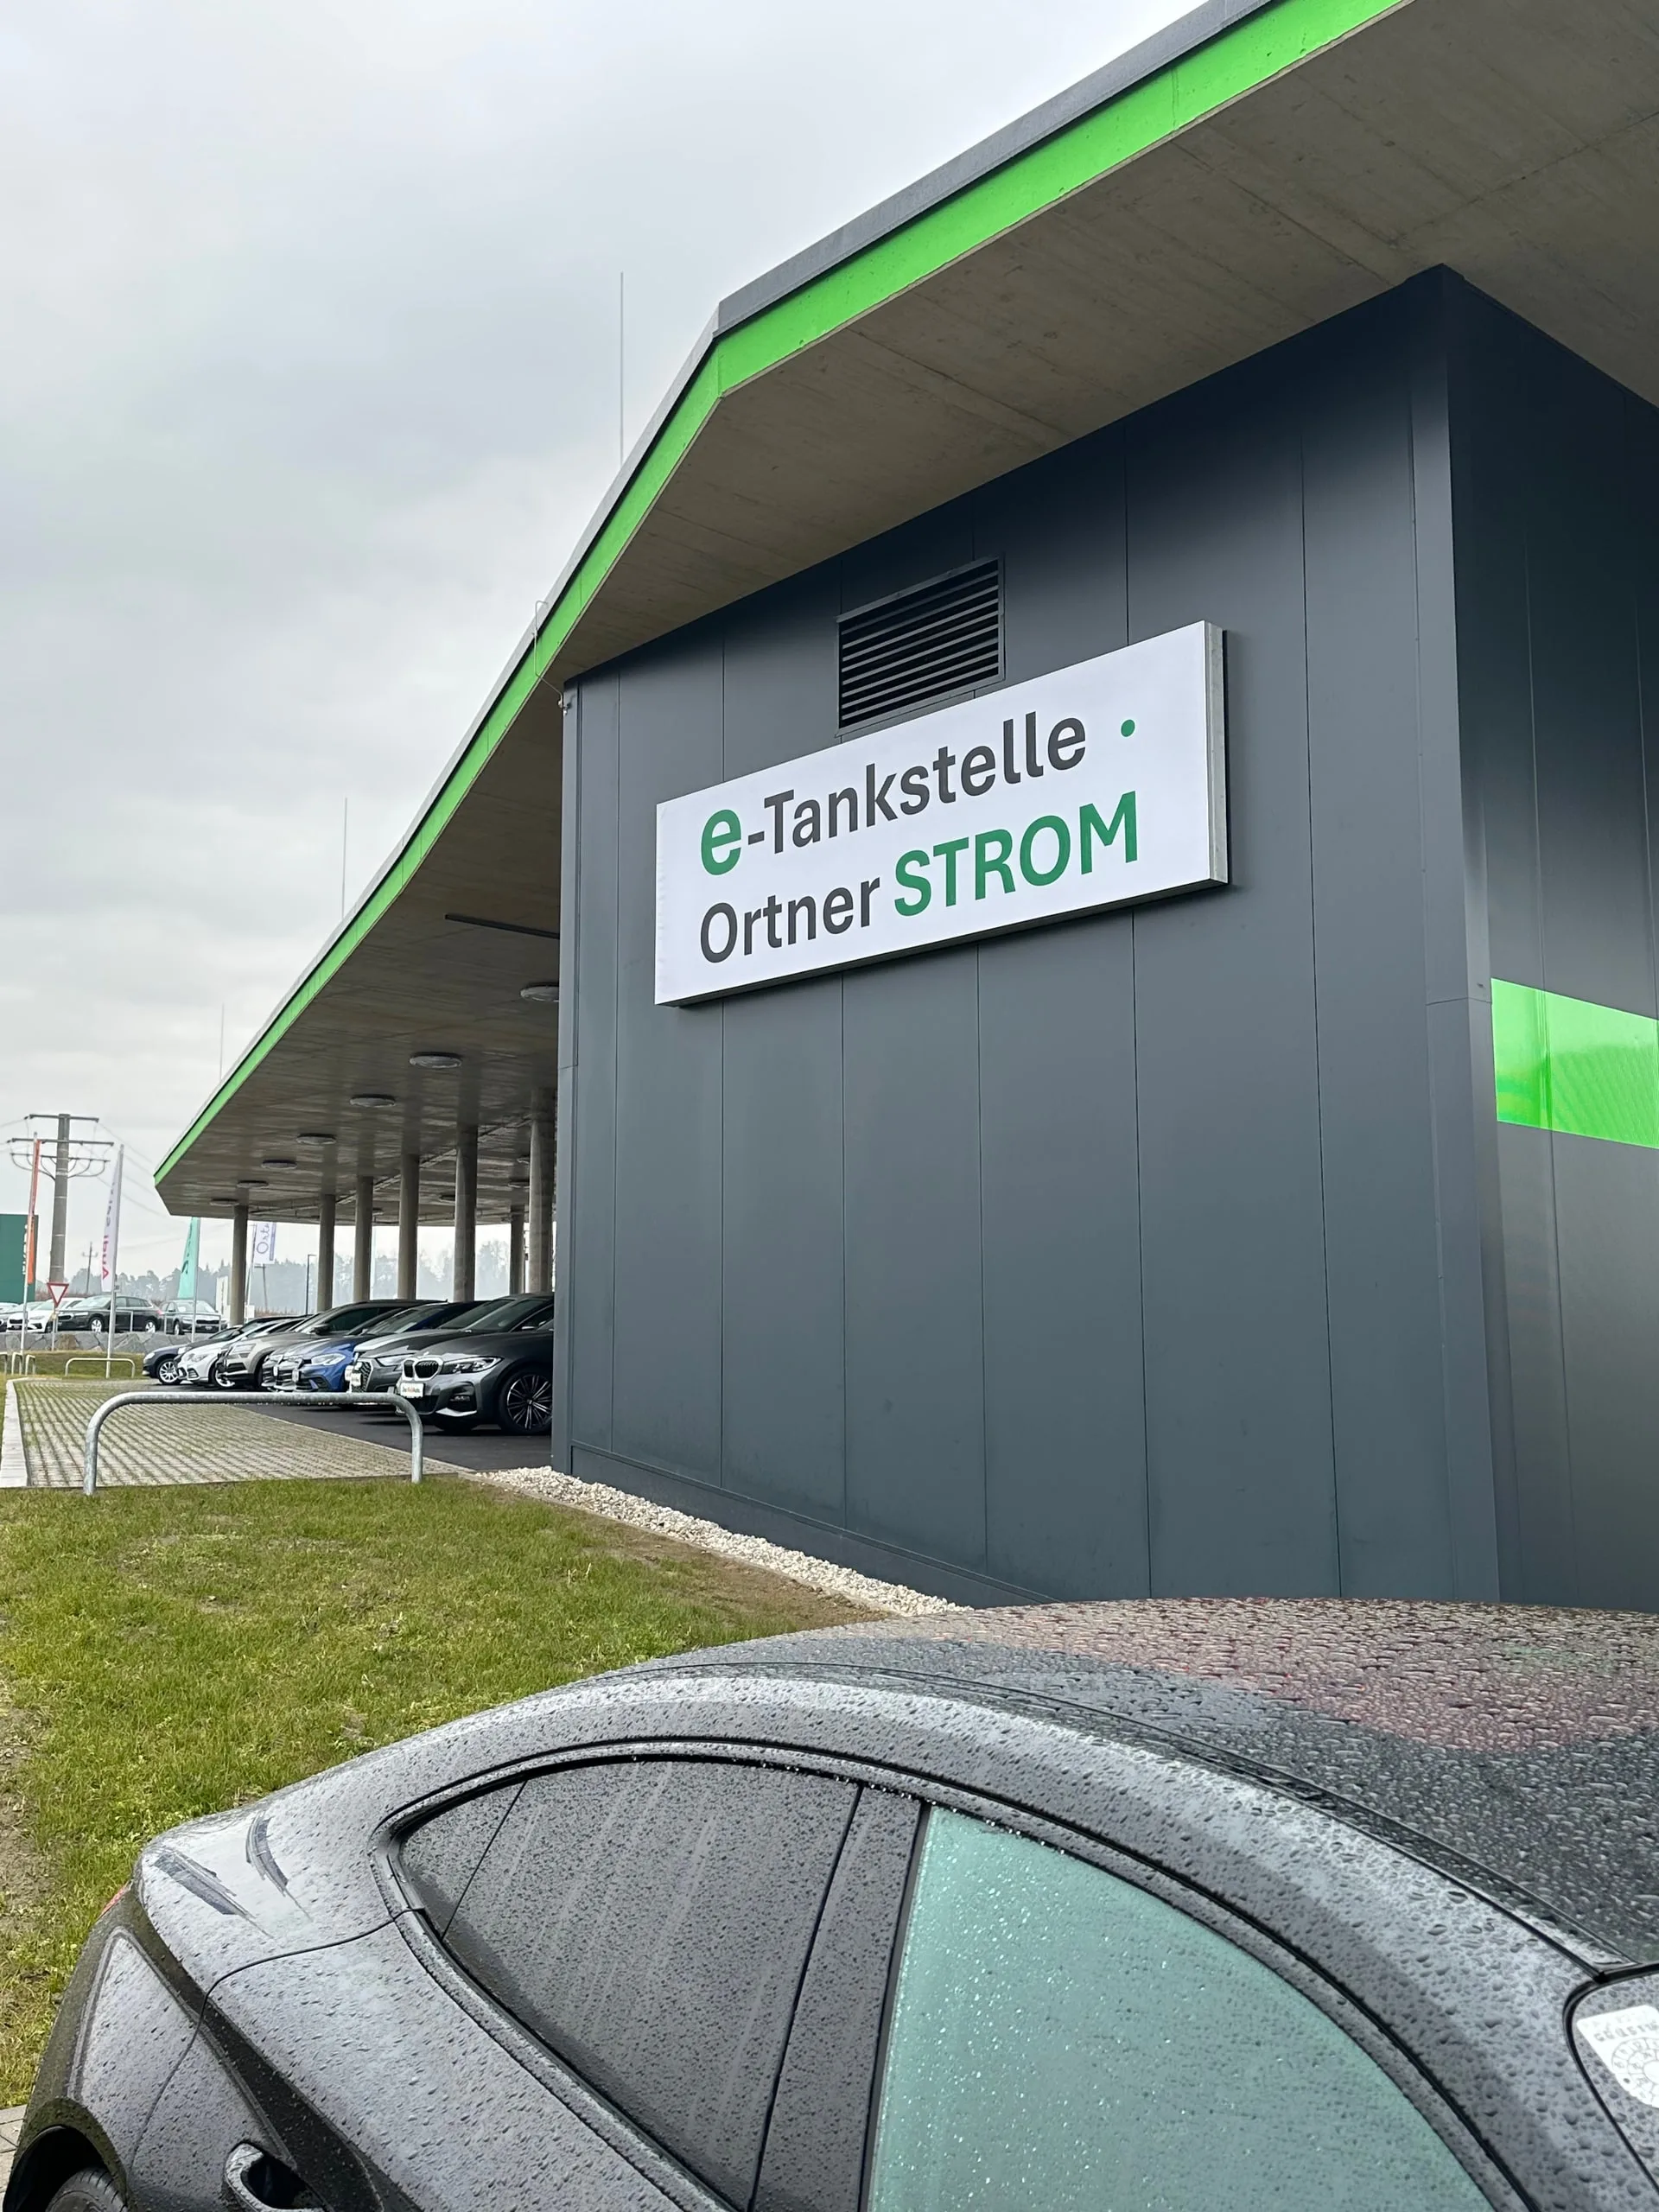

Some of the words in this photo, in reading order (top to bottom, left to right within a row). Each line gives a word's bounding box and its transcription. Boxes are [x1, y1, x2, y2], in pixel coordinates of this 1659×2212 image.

[700, 711, 1086, 875] e-Tankstelle
[700, 877, 880, 963] Ortner
[893, 790, 1138, 917] STROM
